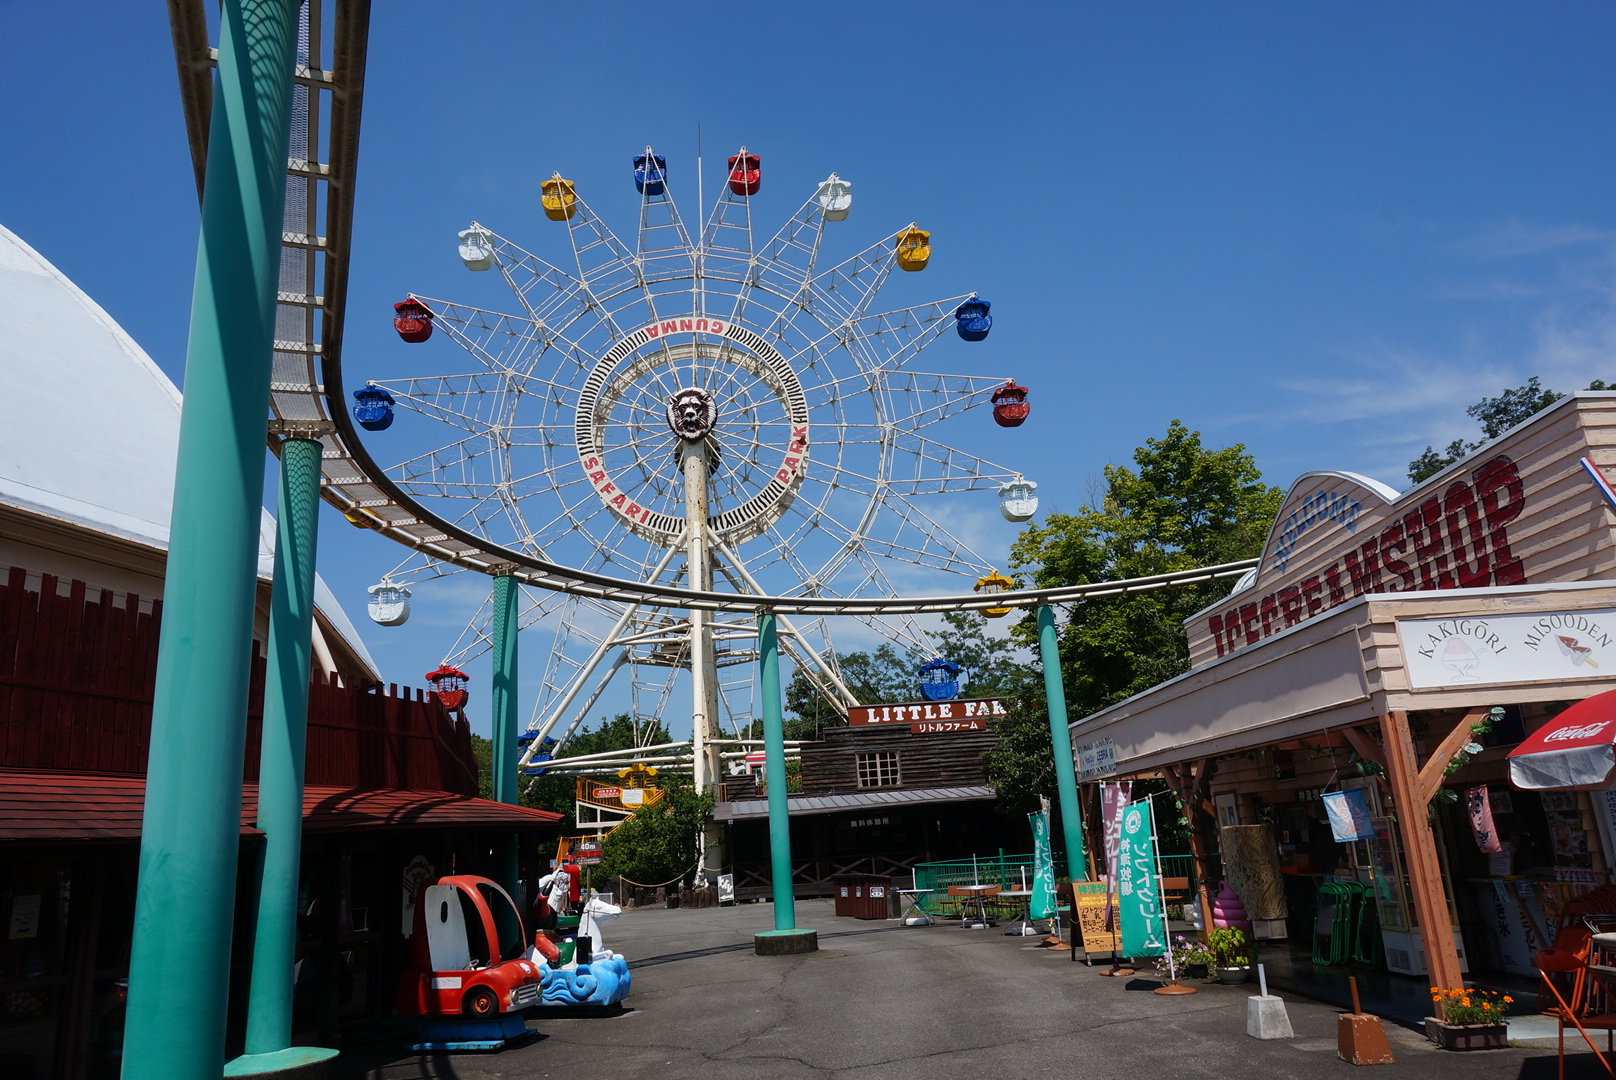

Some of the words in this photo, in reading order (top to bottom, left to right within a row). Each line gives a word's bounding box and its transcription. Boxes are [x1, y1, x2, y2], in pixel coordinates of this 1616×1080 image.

[645, 318, 724, 339] GUNMA
[776, 425, 807, 484] PARK
[582, 456, 651, 524] SAFARI
[1273, 489, 1363, 574] WELCOME
[1523, 613, 1613, 652] MISOODEN
[866, 703, 953, 723] LITTLE
[964, 700, 1008, 717] FAR
[918, 721, 979, 733] リトルファーム
[1078, 884, 1109, 895] 神津牧
